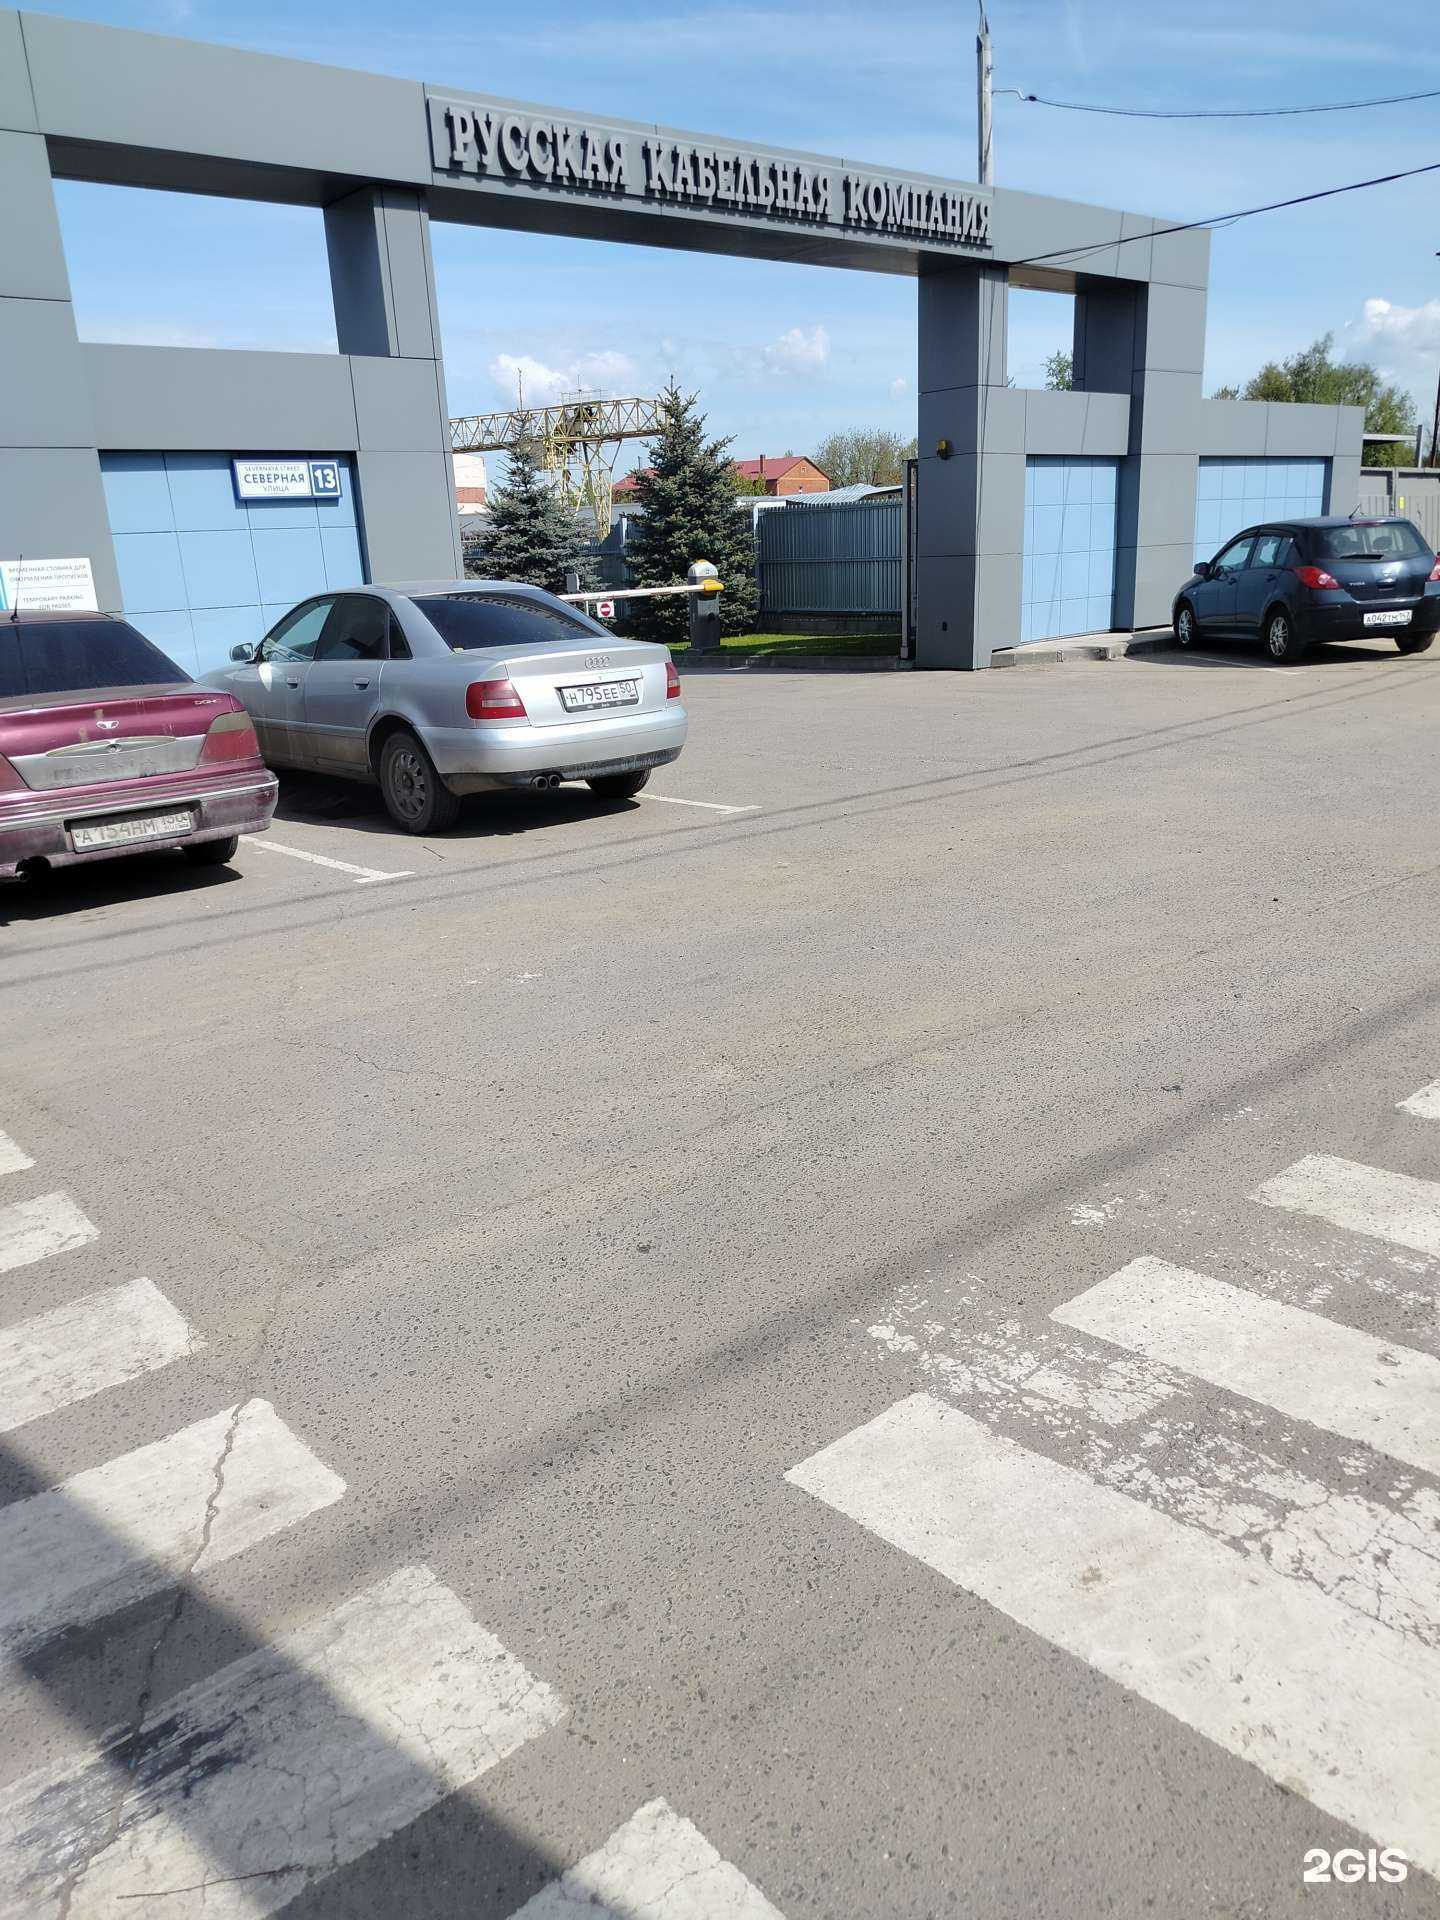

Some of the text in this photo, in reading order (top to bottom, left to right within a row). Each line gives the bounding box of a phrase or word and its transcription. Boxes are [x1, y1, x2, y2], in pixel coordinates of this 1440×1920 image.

[448, 107, 993, 239] РУССКАЯ КАБЕЛЬНАЯ КОМПАНИЯ
[244, 473, 305, 484] СЕВЕРНАЯ
[314, 468, 336, 489] 13
